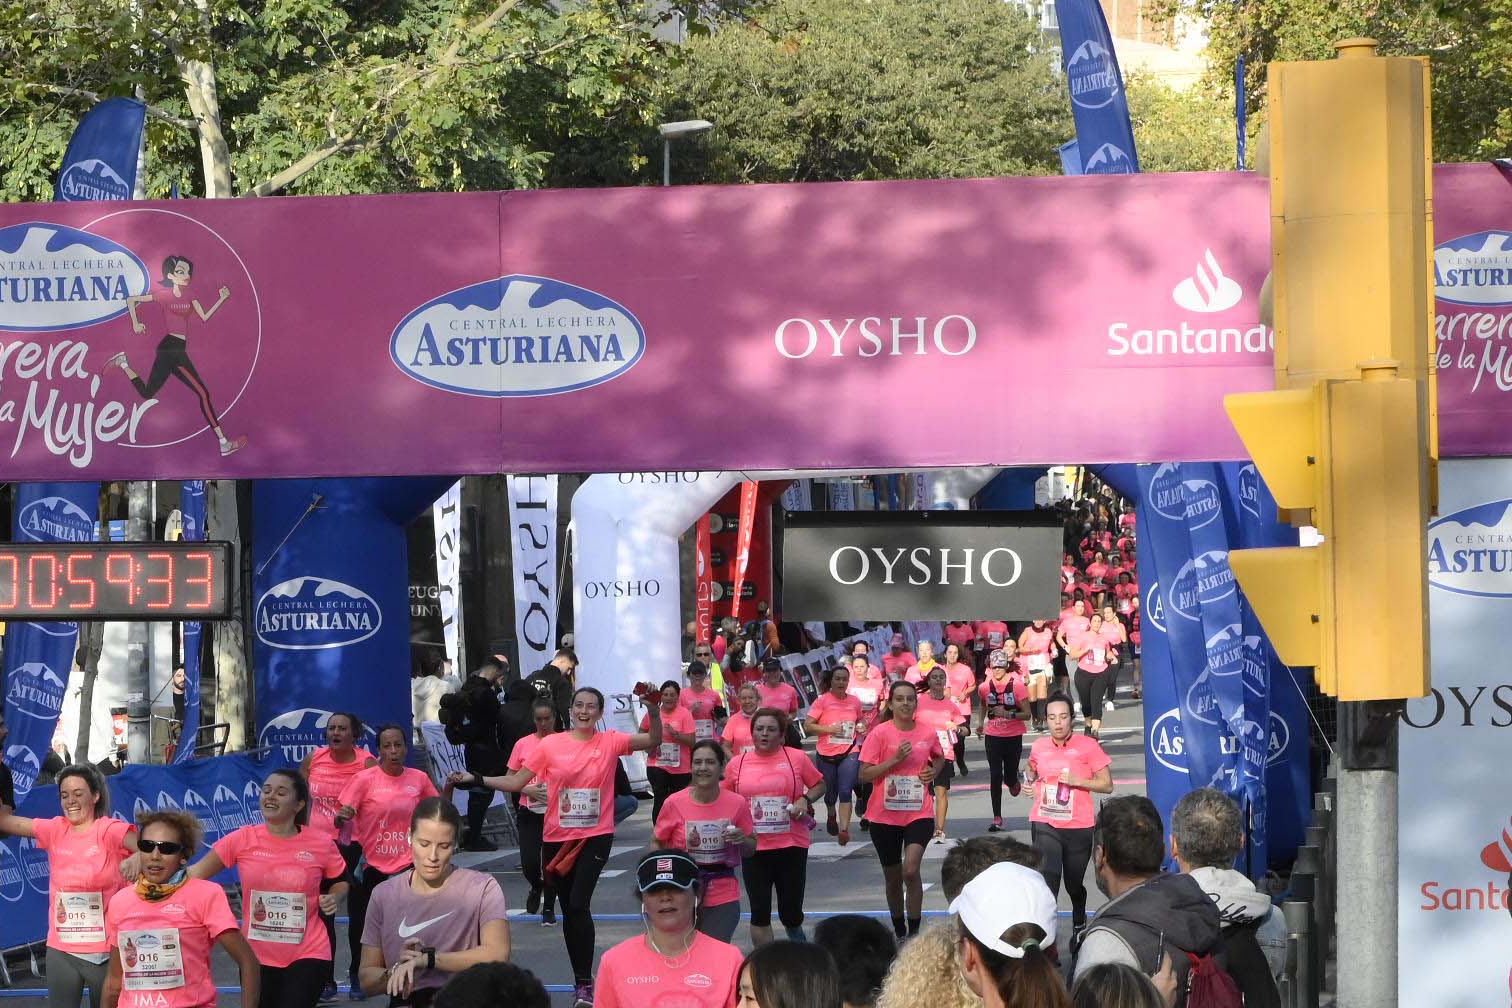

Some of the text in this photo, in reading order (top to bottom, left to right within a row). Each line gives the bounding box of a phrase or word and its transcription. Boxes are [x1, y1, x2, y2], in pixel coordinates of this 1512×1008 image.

[52, 258, 124, 270] LECHERA
[1448, 256, 1498, 265] CENTRAL
[449, 315, 617, 331] CENTRAL LECHERA
[409, 321, 626, 367] ASTURIANA
[774, 314, 977, 359] OYSHO
[1457, 341, 1475, 369] la
[10, 375, 159, 468] Mujer
[828, 545, 1023, 588] OYSHO
[585, 579, 661, 599] OYSHO
[272, 601, 368, 609] CENTRAL LECHERA
[259, 606, 373, 633] ASTURIANA
[68, 912, 86, 920] 016
[268, 911, 287, 920] 016
[138, 953, 159, 962] 016
[626, 975, 660, 985] OYSHO
